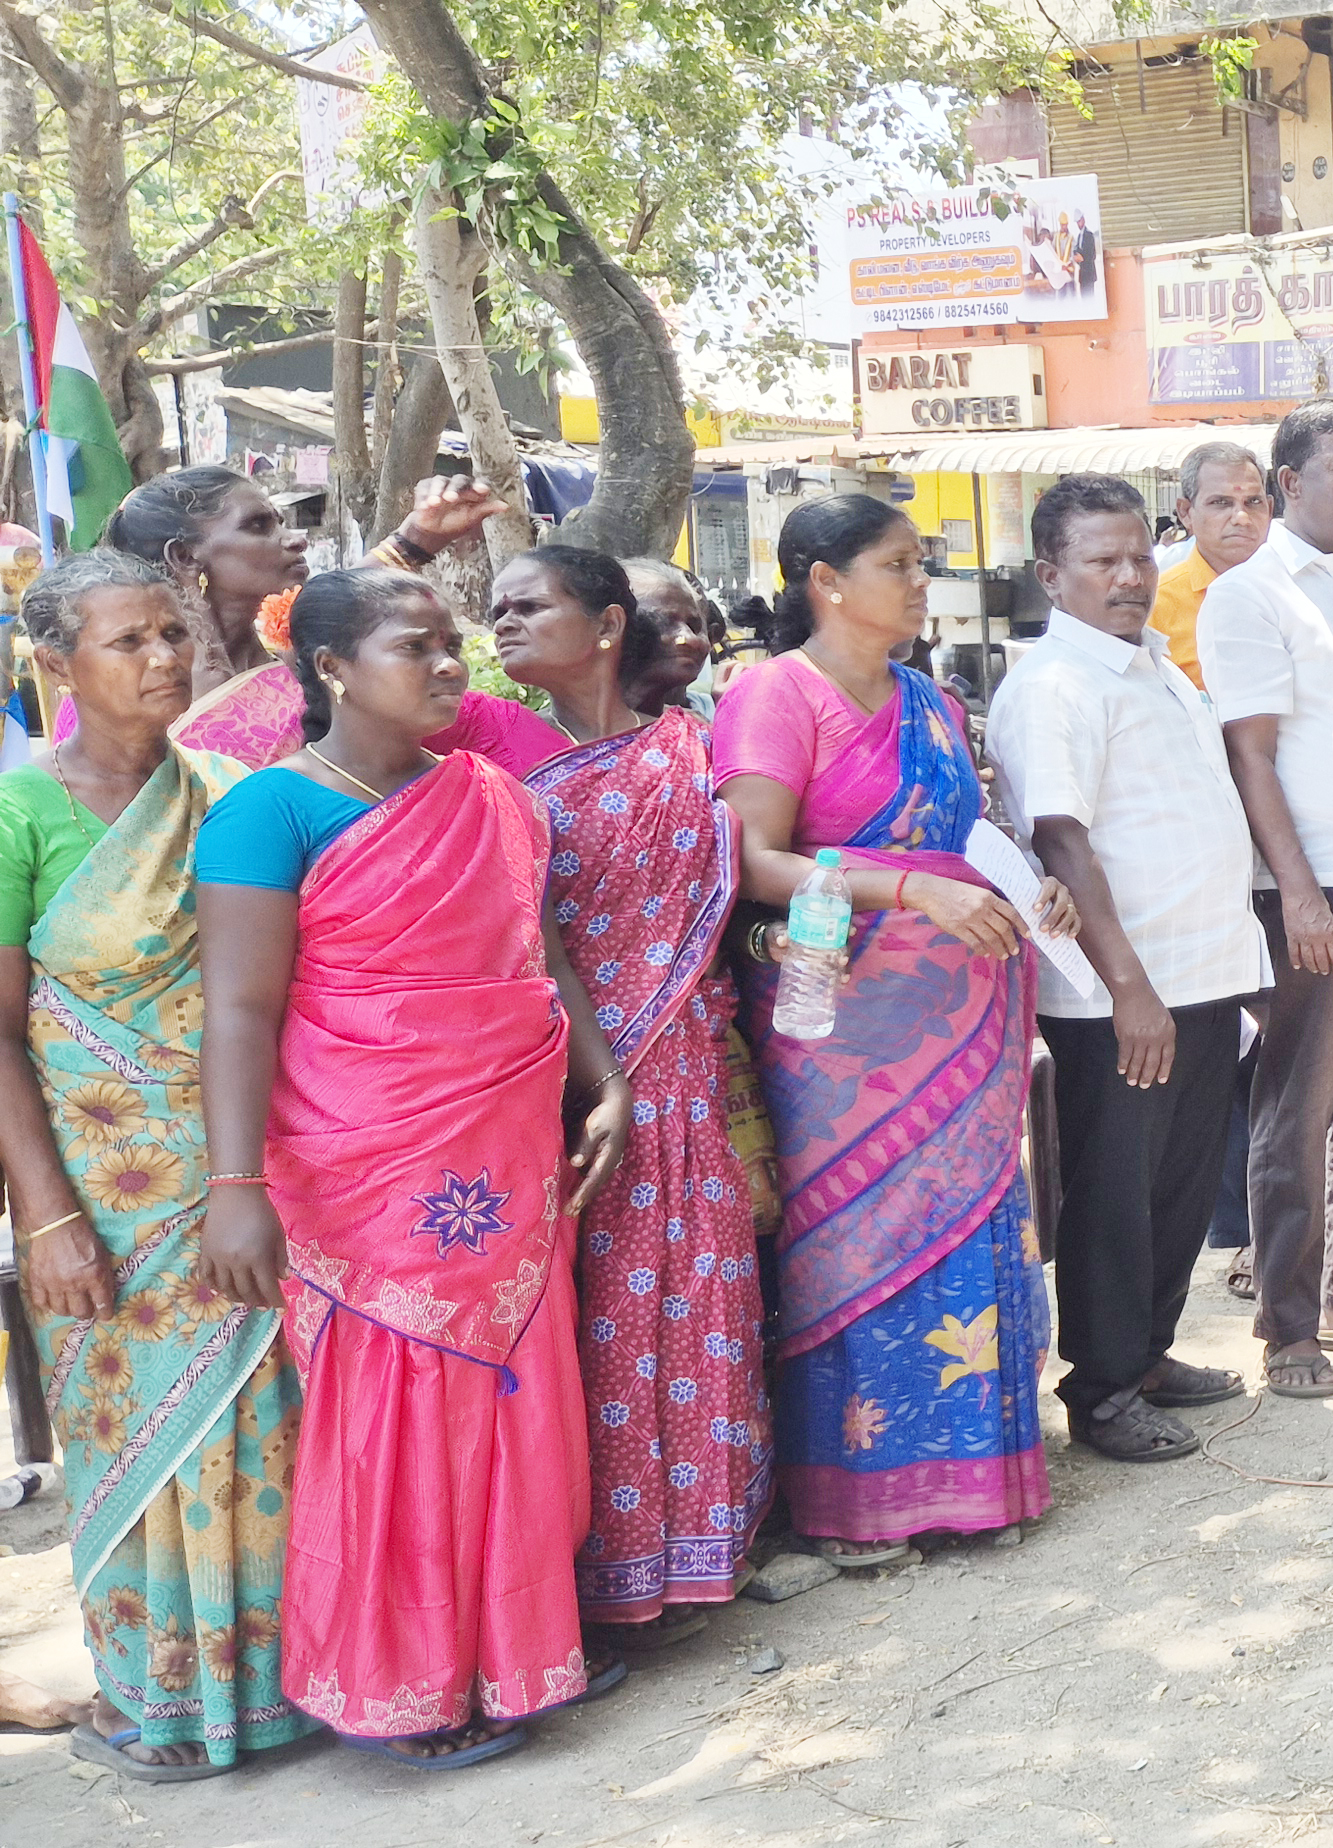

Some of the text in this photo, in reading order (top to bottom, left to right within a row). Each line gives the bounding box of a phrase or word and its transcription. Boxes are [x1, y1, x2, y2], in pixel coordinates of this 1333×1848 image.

[880, 231, 991, 250] PROPERTY DEVELOPERS
[873, 307, 935, 322] 9842312566
[944, 302, 1009, 318] 8825474560
[1157, 265, 1264, 334] பாரத்
[866, 352, 972, 392] BARAT
[912, 395, 1021, 428] COFFEE
